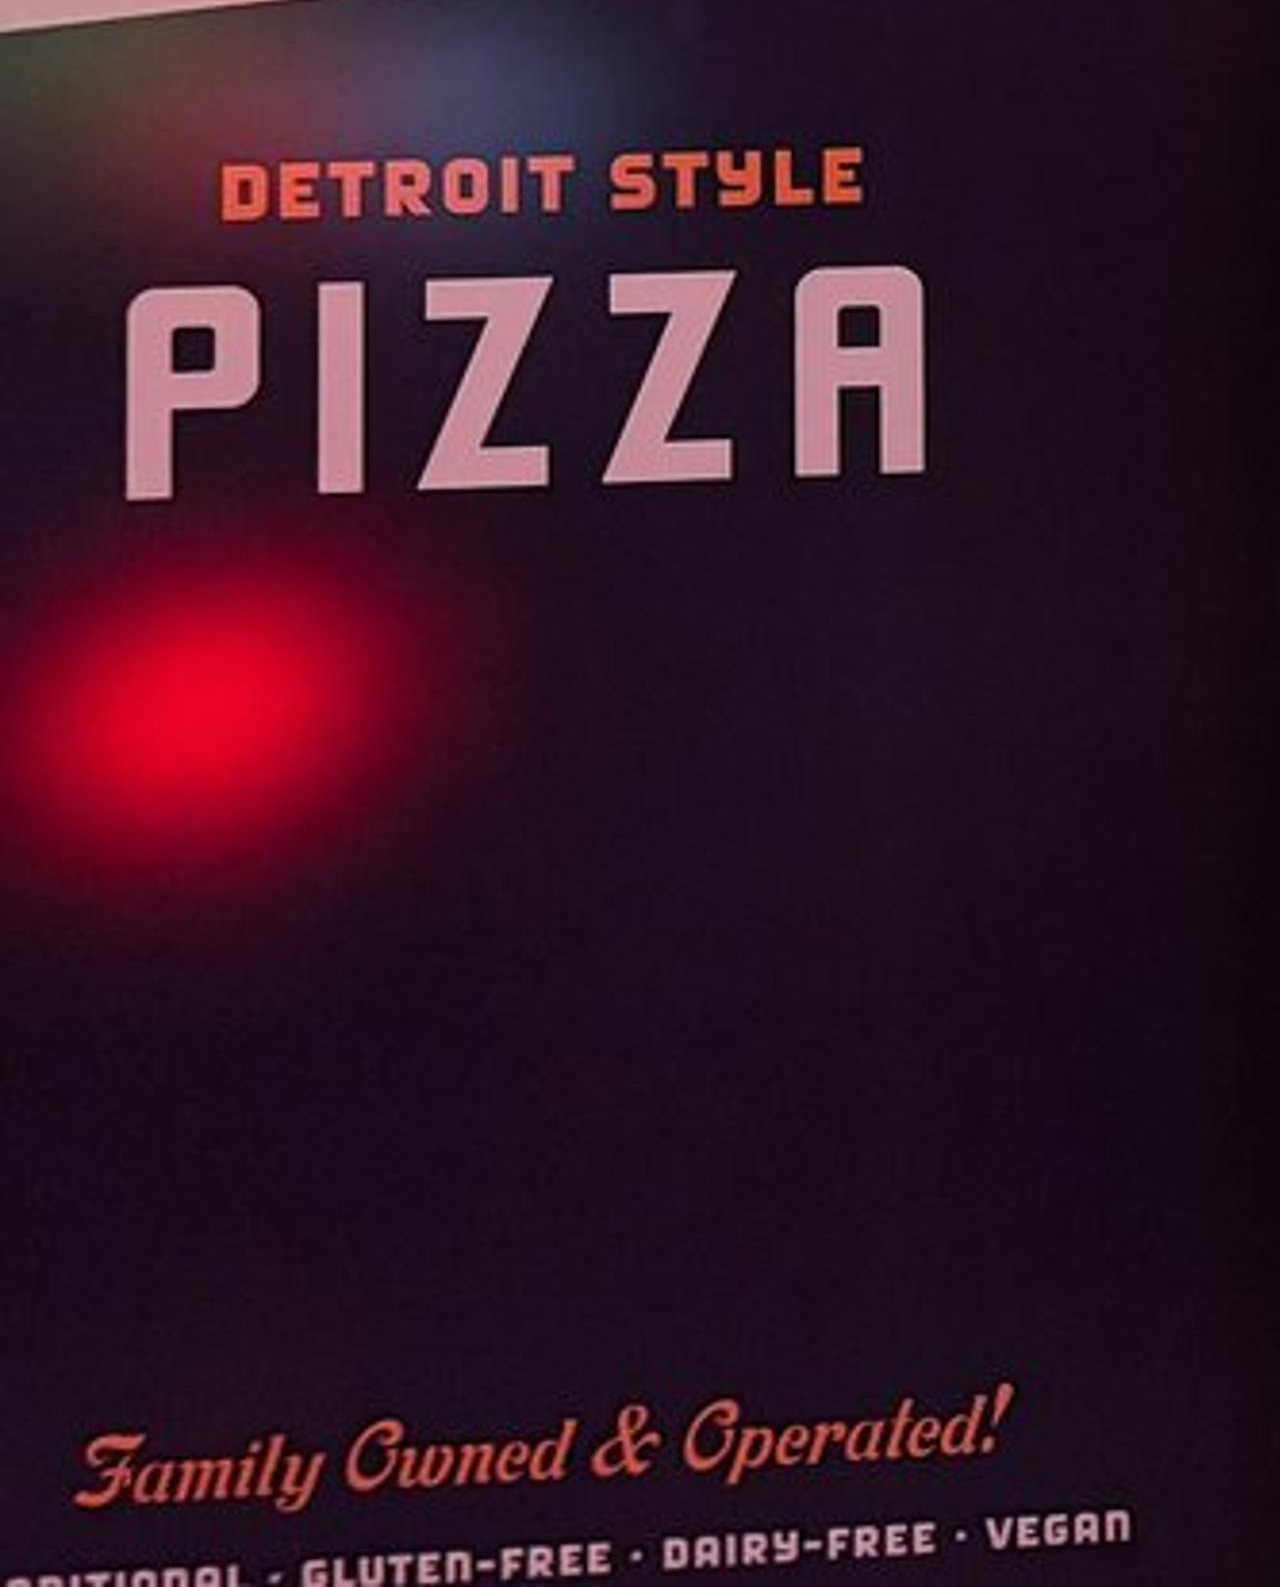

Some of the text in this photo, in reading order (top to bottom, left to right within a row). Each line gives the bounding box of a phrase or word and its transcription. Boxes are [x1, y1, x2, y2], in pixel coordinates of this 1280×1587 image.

[220, 146, 865, 222] DETROIT STYLE
[125, 264, 927, 503] PIZZA
[73, 1381, 1015, 1513] Family Owned & Operated!
[302, 1542, 611, 1587] GLUTEN-FREE
[661, 1521, 938, 1571] DAIRY-FREE
[985, 1508, 1132, 1550] VEGAN
